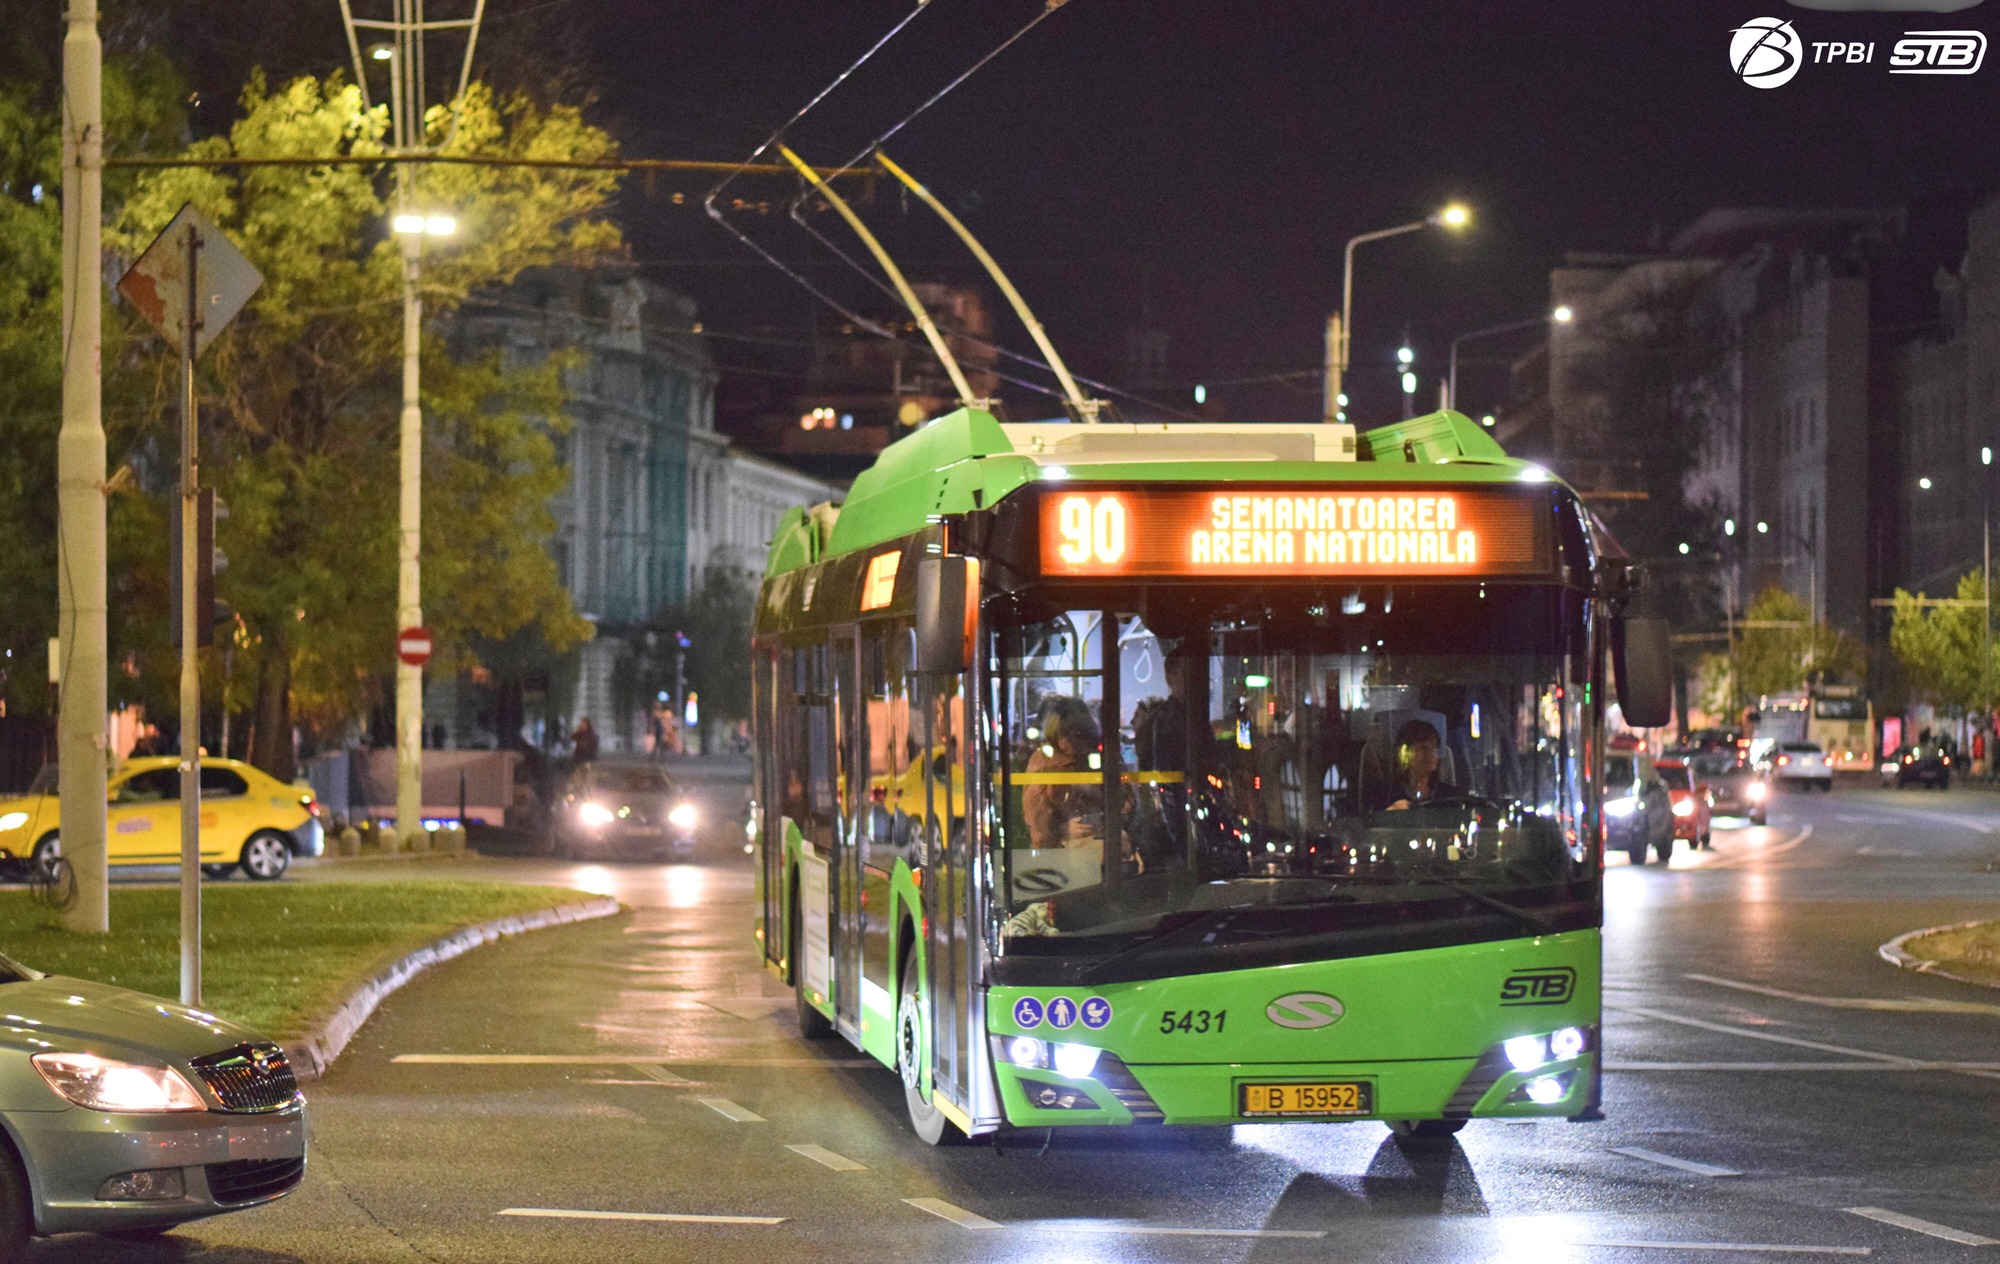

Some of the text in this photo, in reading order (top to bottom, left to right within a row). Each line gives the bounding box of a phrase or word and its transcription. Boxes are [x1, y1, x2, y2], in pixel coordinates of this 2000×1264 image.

[1211, 498, 1456, 530] SEMANATOAREA
[1059, 497, 1125, 563] 90
[1191, 530, 1477, 563] ARENA NATIONALA
[1500, 973, 1570, 1000] STB
[1159, 1009, 1227, 1034] 5431
[1269, 1087, 1355, 1109] B 15952
